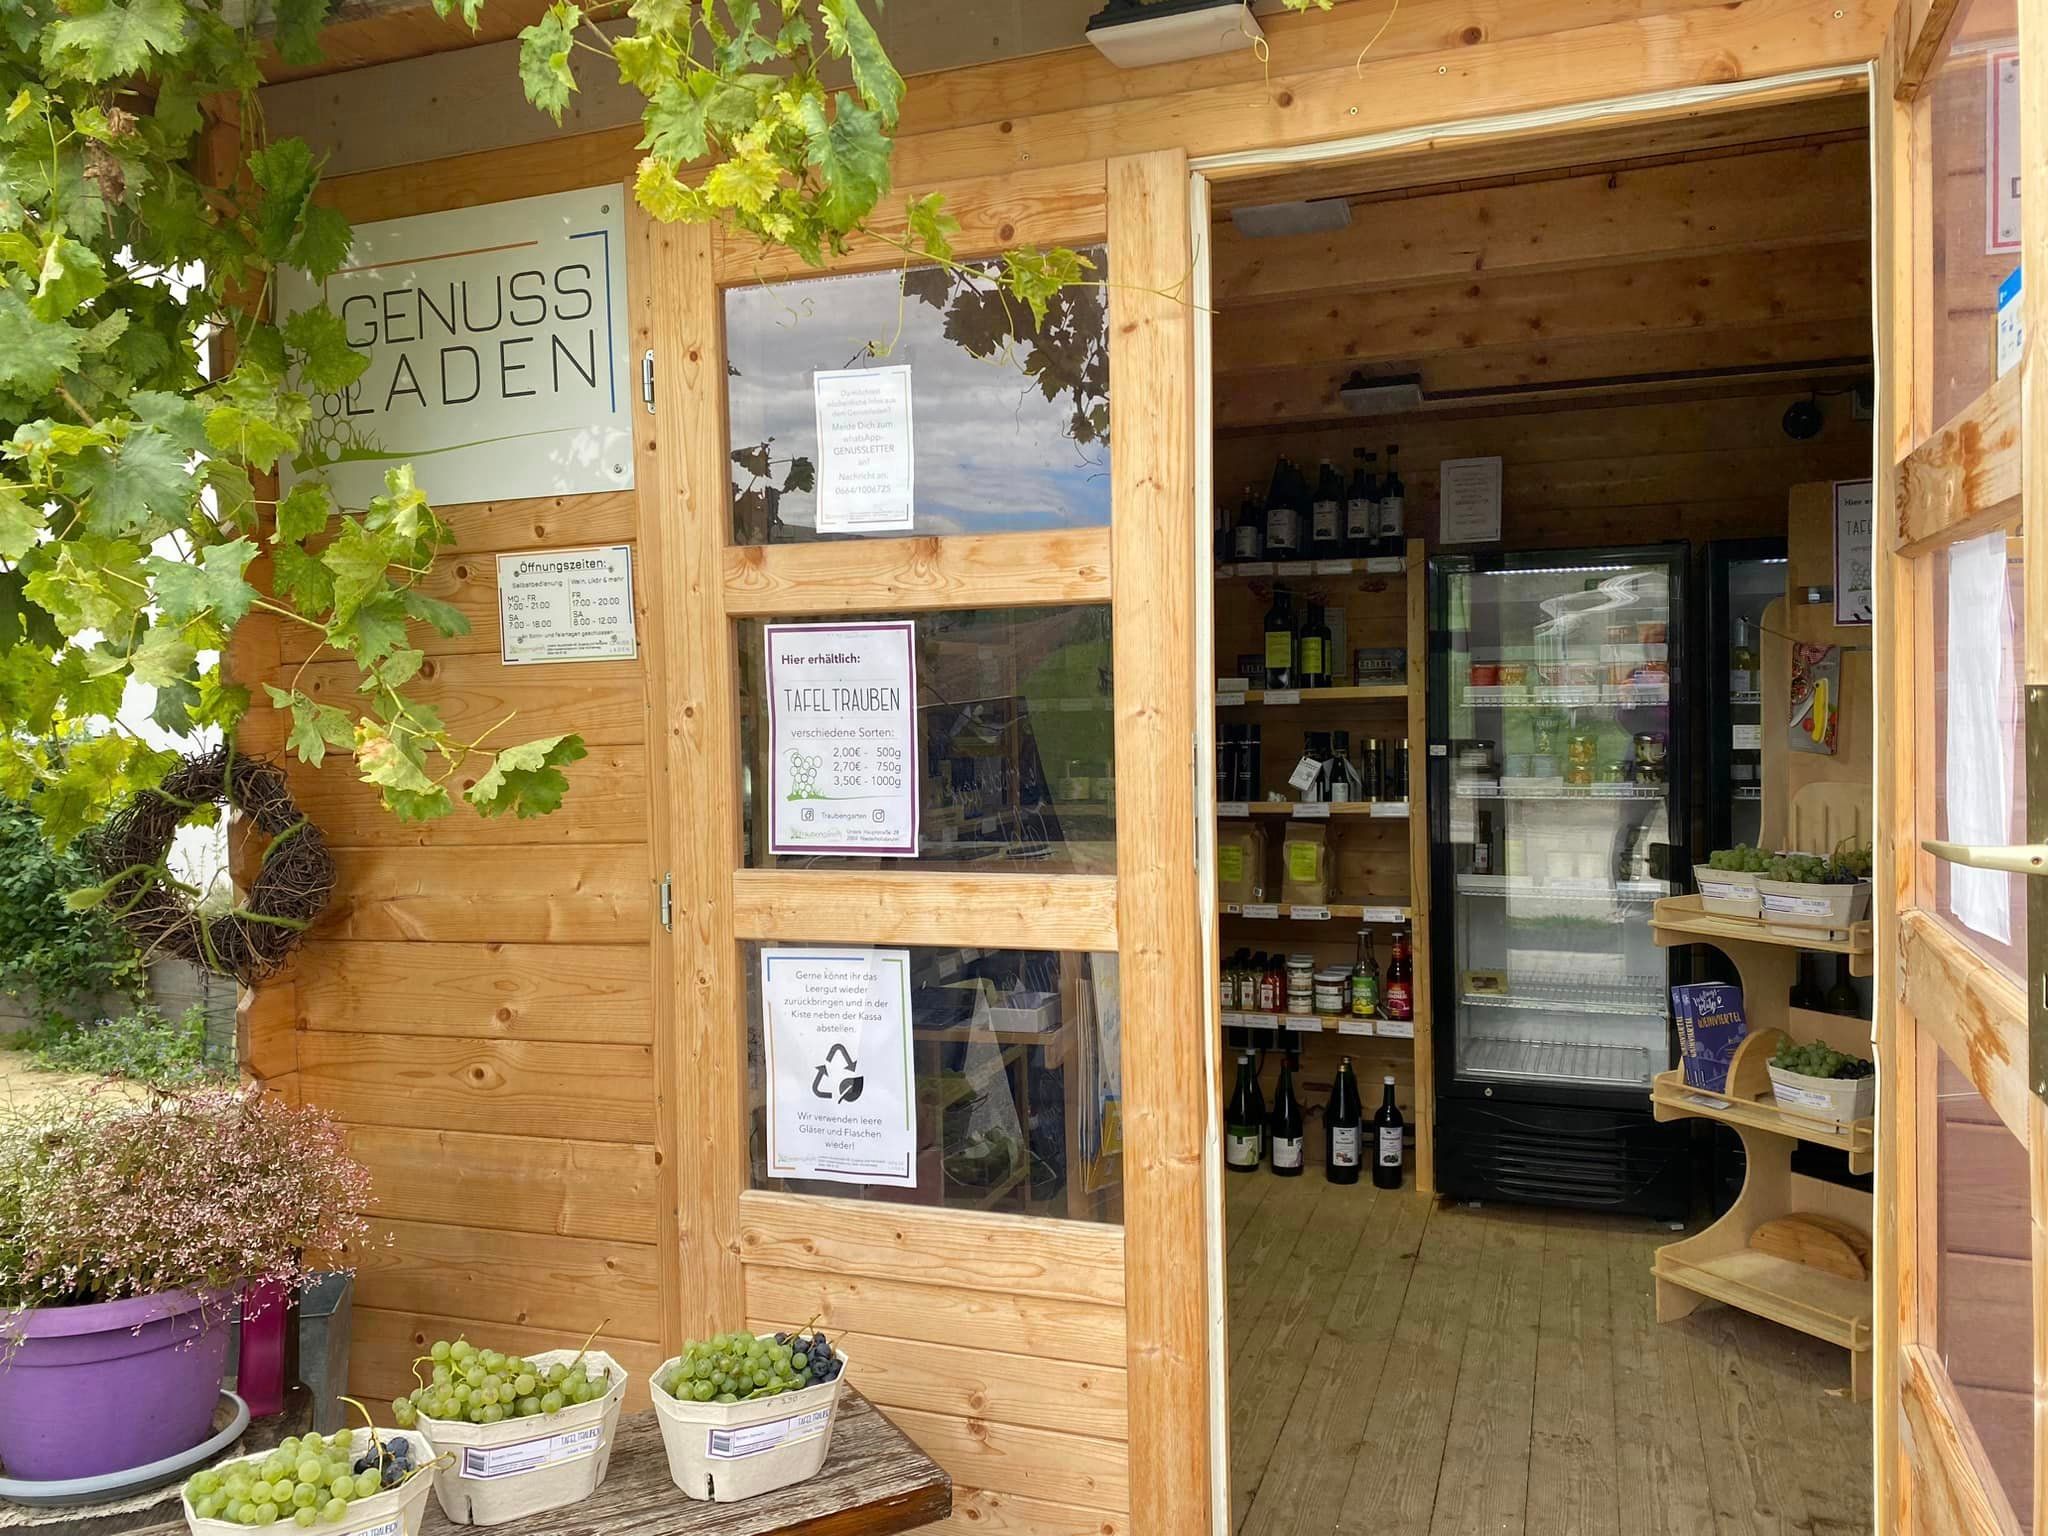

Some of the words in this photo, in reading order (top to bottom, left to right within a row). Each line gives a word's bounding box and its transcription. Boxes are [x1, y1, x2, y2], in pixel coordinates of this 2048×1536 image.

[341, 263, 592, 348] GENUSS
[345, 329, 596, 417] LADEN
[833, 444, 895, 456] GENUSSLETTER
[520, 559, 607, 573] Öffnungszeiten:
[507, 595, 519, 603] MO
[527, 594, 536, 602] FR
[573, 610, 583, 618] SA
[781, 654, 804, 665] Hier
[808, 653, 861, 665] erhältlich:
[784, 687, 901, 713] TAFELTRAUBEN
[791, 727, 856, 739] verschiedene
[859, 727, 895, 738] Sorten:
[833, 747, 861, 759] 2,00€
[876, 746, 902, 760] 500g
[833, 761, 861, 773] 2,70€
[877, 761, 902, 774] 750g
[833, 775, 862, 788] 3,50€
[871, 775, 902, 788] 1000g
[821, 811, 867, 821] Traubengarten
[795, 970, 821, 981] Gerne
[824, 969, 848, 981] könnt
[850, 971, 861, 981] ihr
[862, 971, 878, 981] das
[805, 984, 838, 996] Leergut
[839, 984, 869, 994] wieder
[784, 996, 844, 1009] zurückbringen
[845, 998, 863, 1009] und
[865, 999, 872, 1009] in
[874, 998, 889, 1009] der
[791, 1009, 812, 1020] Kiste
[813, 1010, 840, 1021] neben
[841, 1011, 857, 1021] der
[858, 1012, 883, 1022] Kassa
[816, 1023, 857, 1034] abstellen.
[797, 1111, 812, 1122] Wir
[813, 1113, 858, 1125] verwenden
[860, 1116, 883, 1126] leere
[799, 1124, 825, 1136] Gläser
[827, 1126, 843, 1137] und
[844, 1127, 882, 1140] Flaschen
[825, 1140, 855, 1151] wieder!
